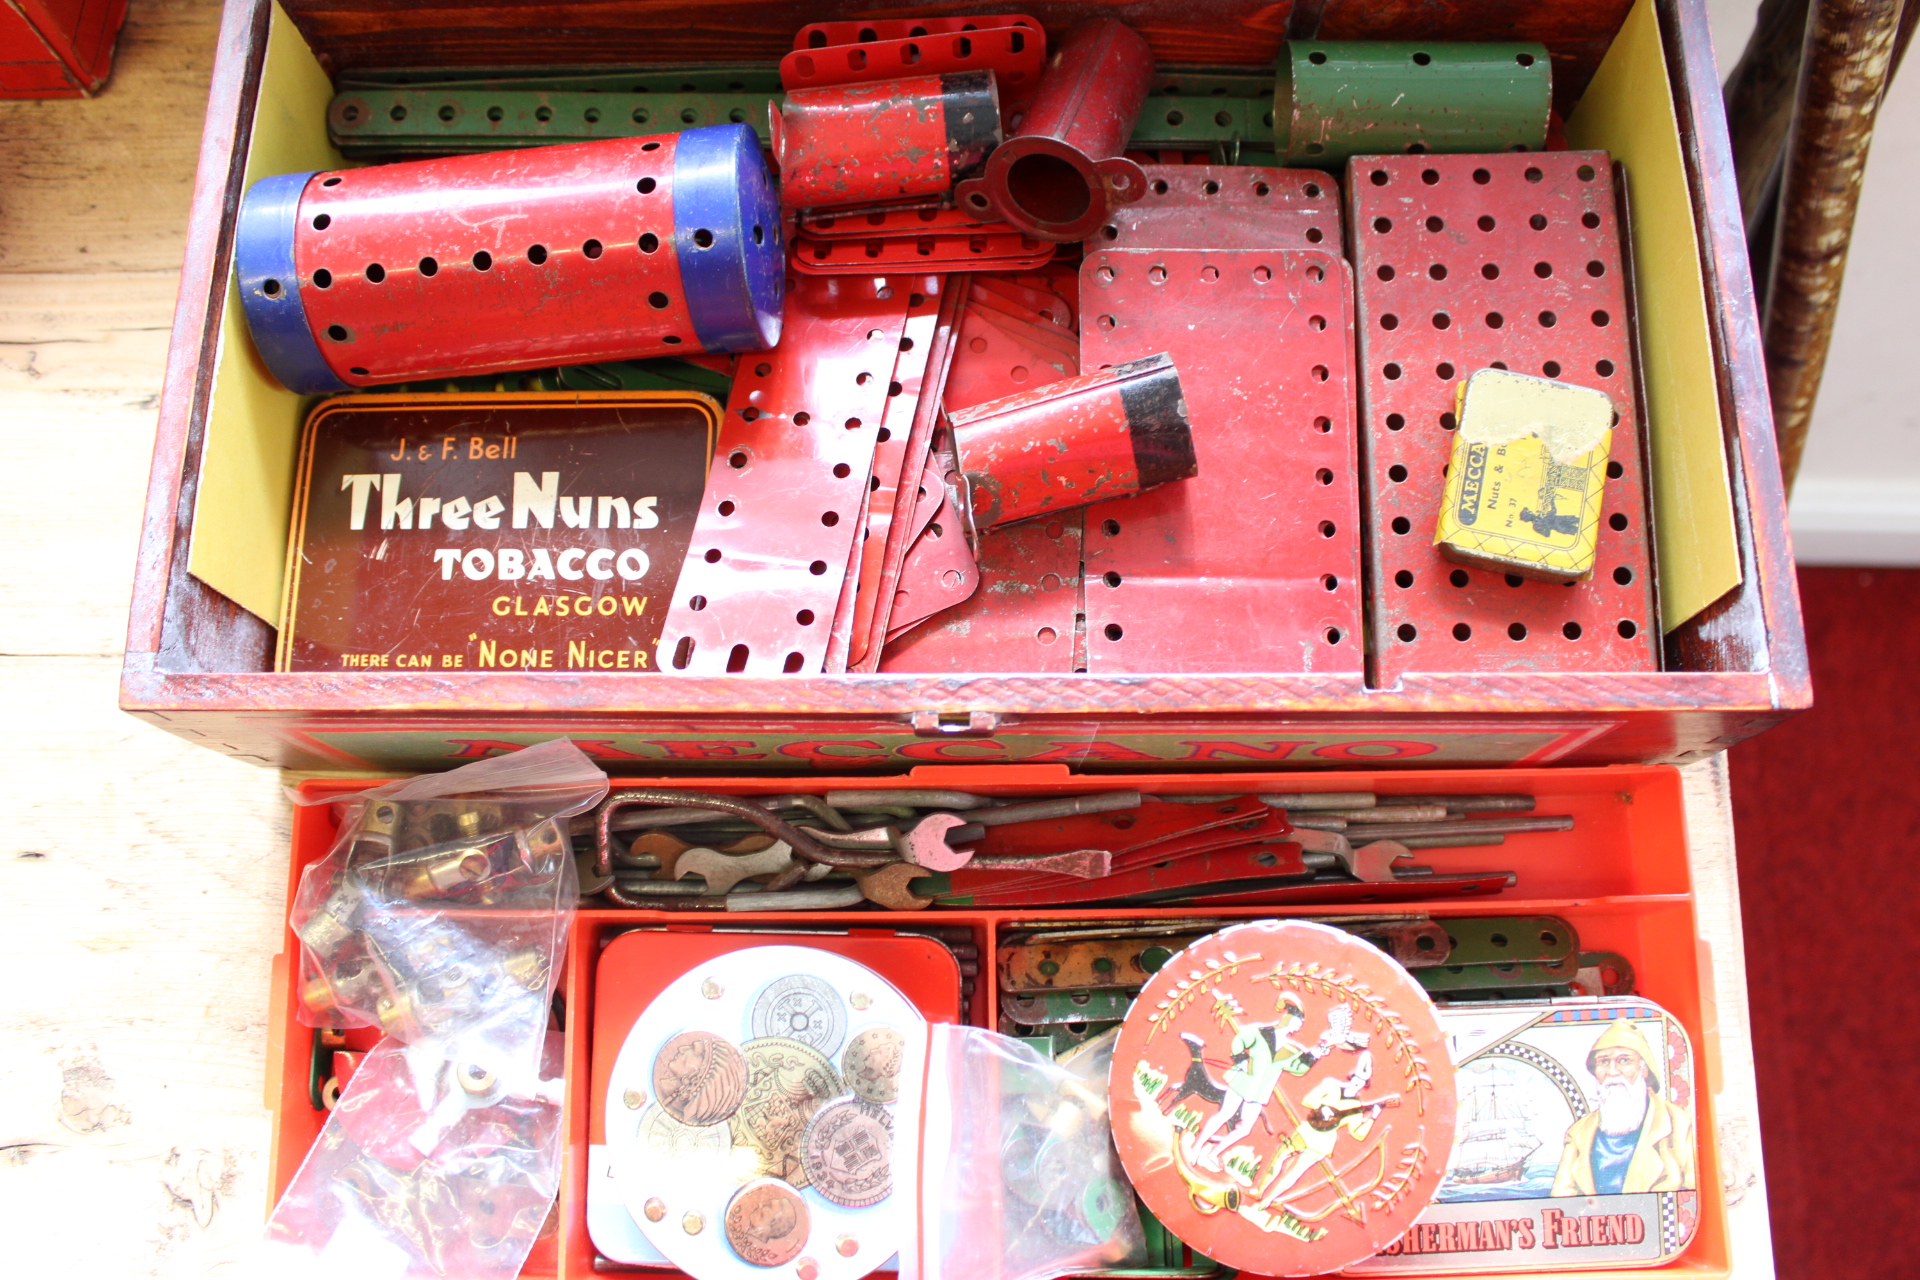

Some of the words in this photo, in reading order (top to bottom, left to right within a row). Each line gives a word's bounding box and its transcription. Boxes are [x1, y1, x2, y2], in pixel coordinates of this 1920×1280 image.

[390, 437, 412, 461] J.
[417, 445, 432, 461] &
[442, 437, 458, 461] F.
[468, 436, 517, 460] Bell
[1494, 464, 1504, 474] &
[341, 472, 506, 531] Three
[512, 471, 660, 530] Nuns
[1487, 481, 1502, 510] Nuts
[434, 547, 651, 581] TOBACCO
[491, 594, 648, 617] GLASGOW
[341, 653, 390, 669] THERE
[395, 654, 433, 669] CAN
[442, 654, 464, 669] BE
[1541, 1208, 1645, 1250] FRIEND
